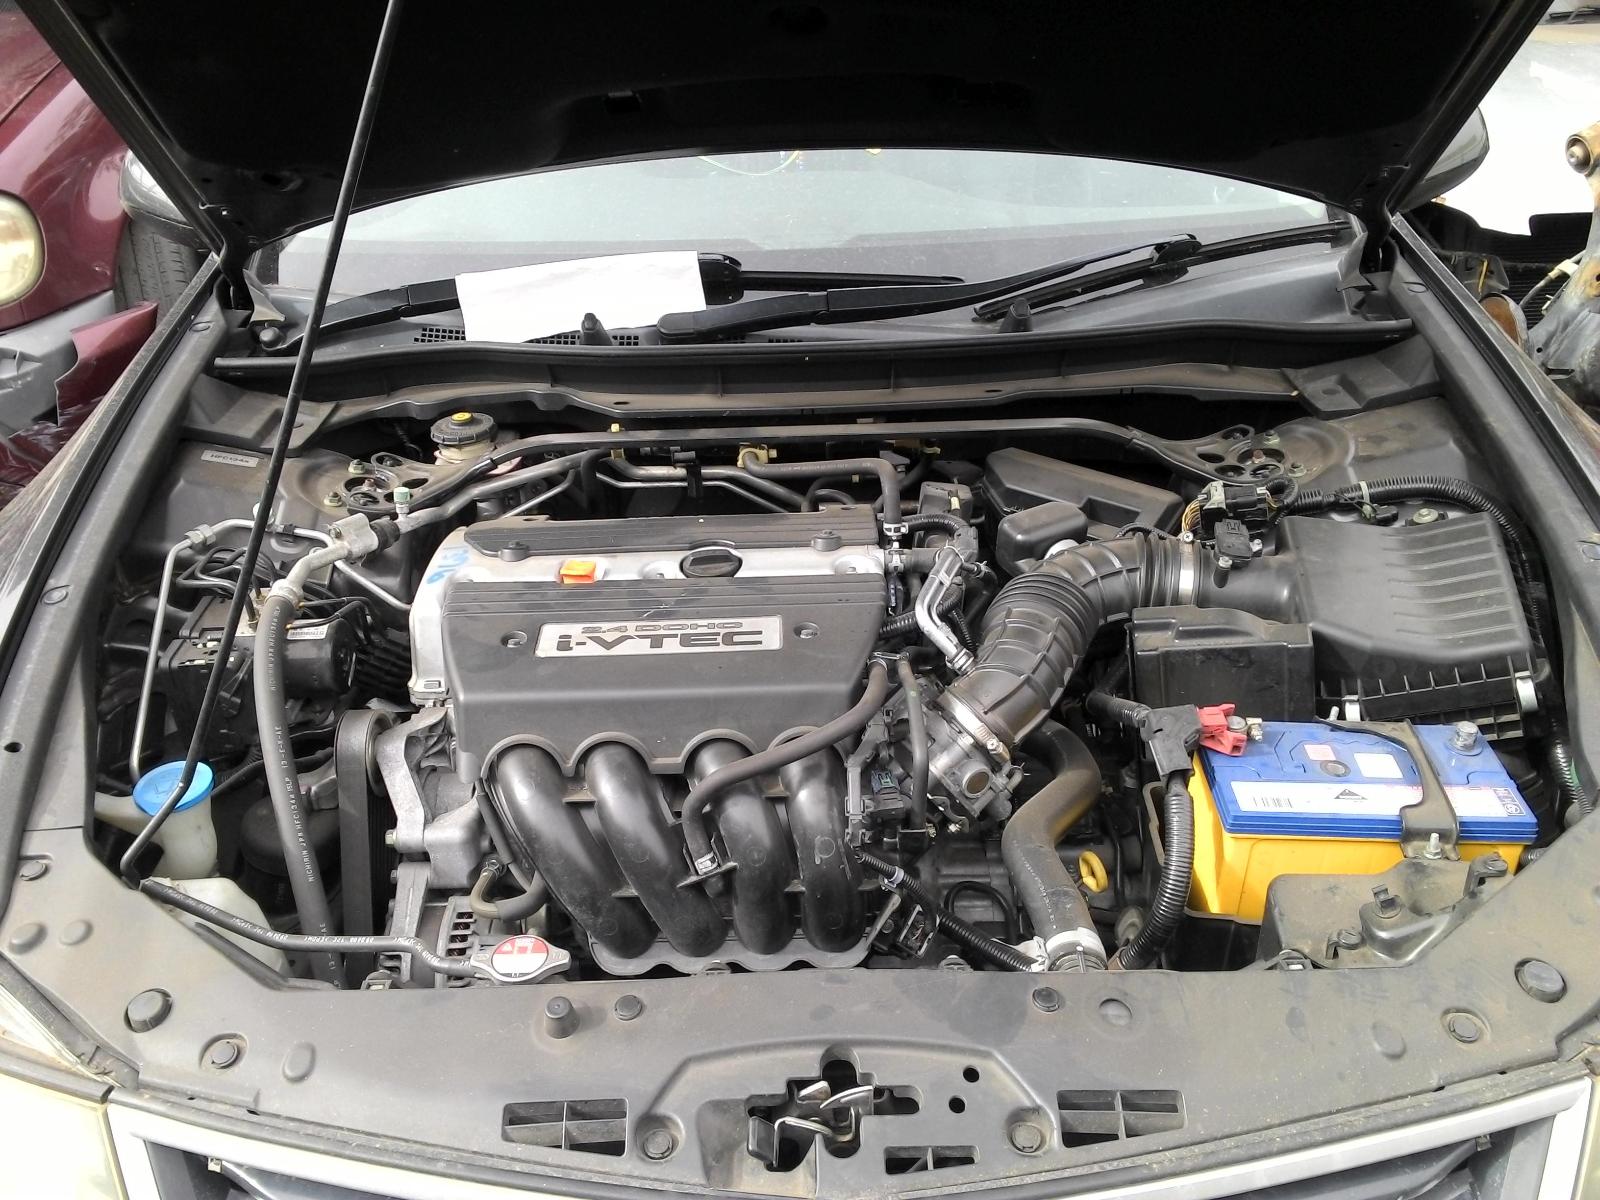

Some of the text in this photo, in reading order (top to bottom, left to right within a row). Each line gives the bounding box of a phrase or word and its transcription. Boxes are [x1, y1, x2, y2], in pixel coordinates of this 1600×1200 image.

[581, 625, 629, 634] 2.4
[556, 630, 763, 651] i-VTEC
[302, 850, 315, 882] NICHIRIN
